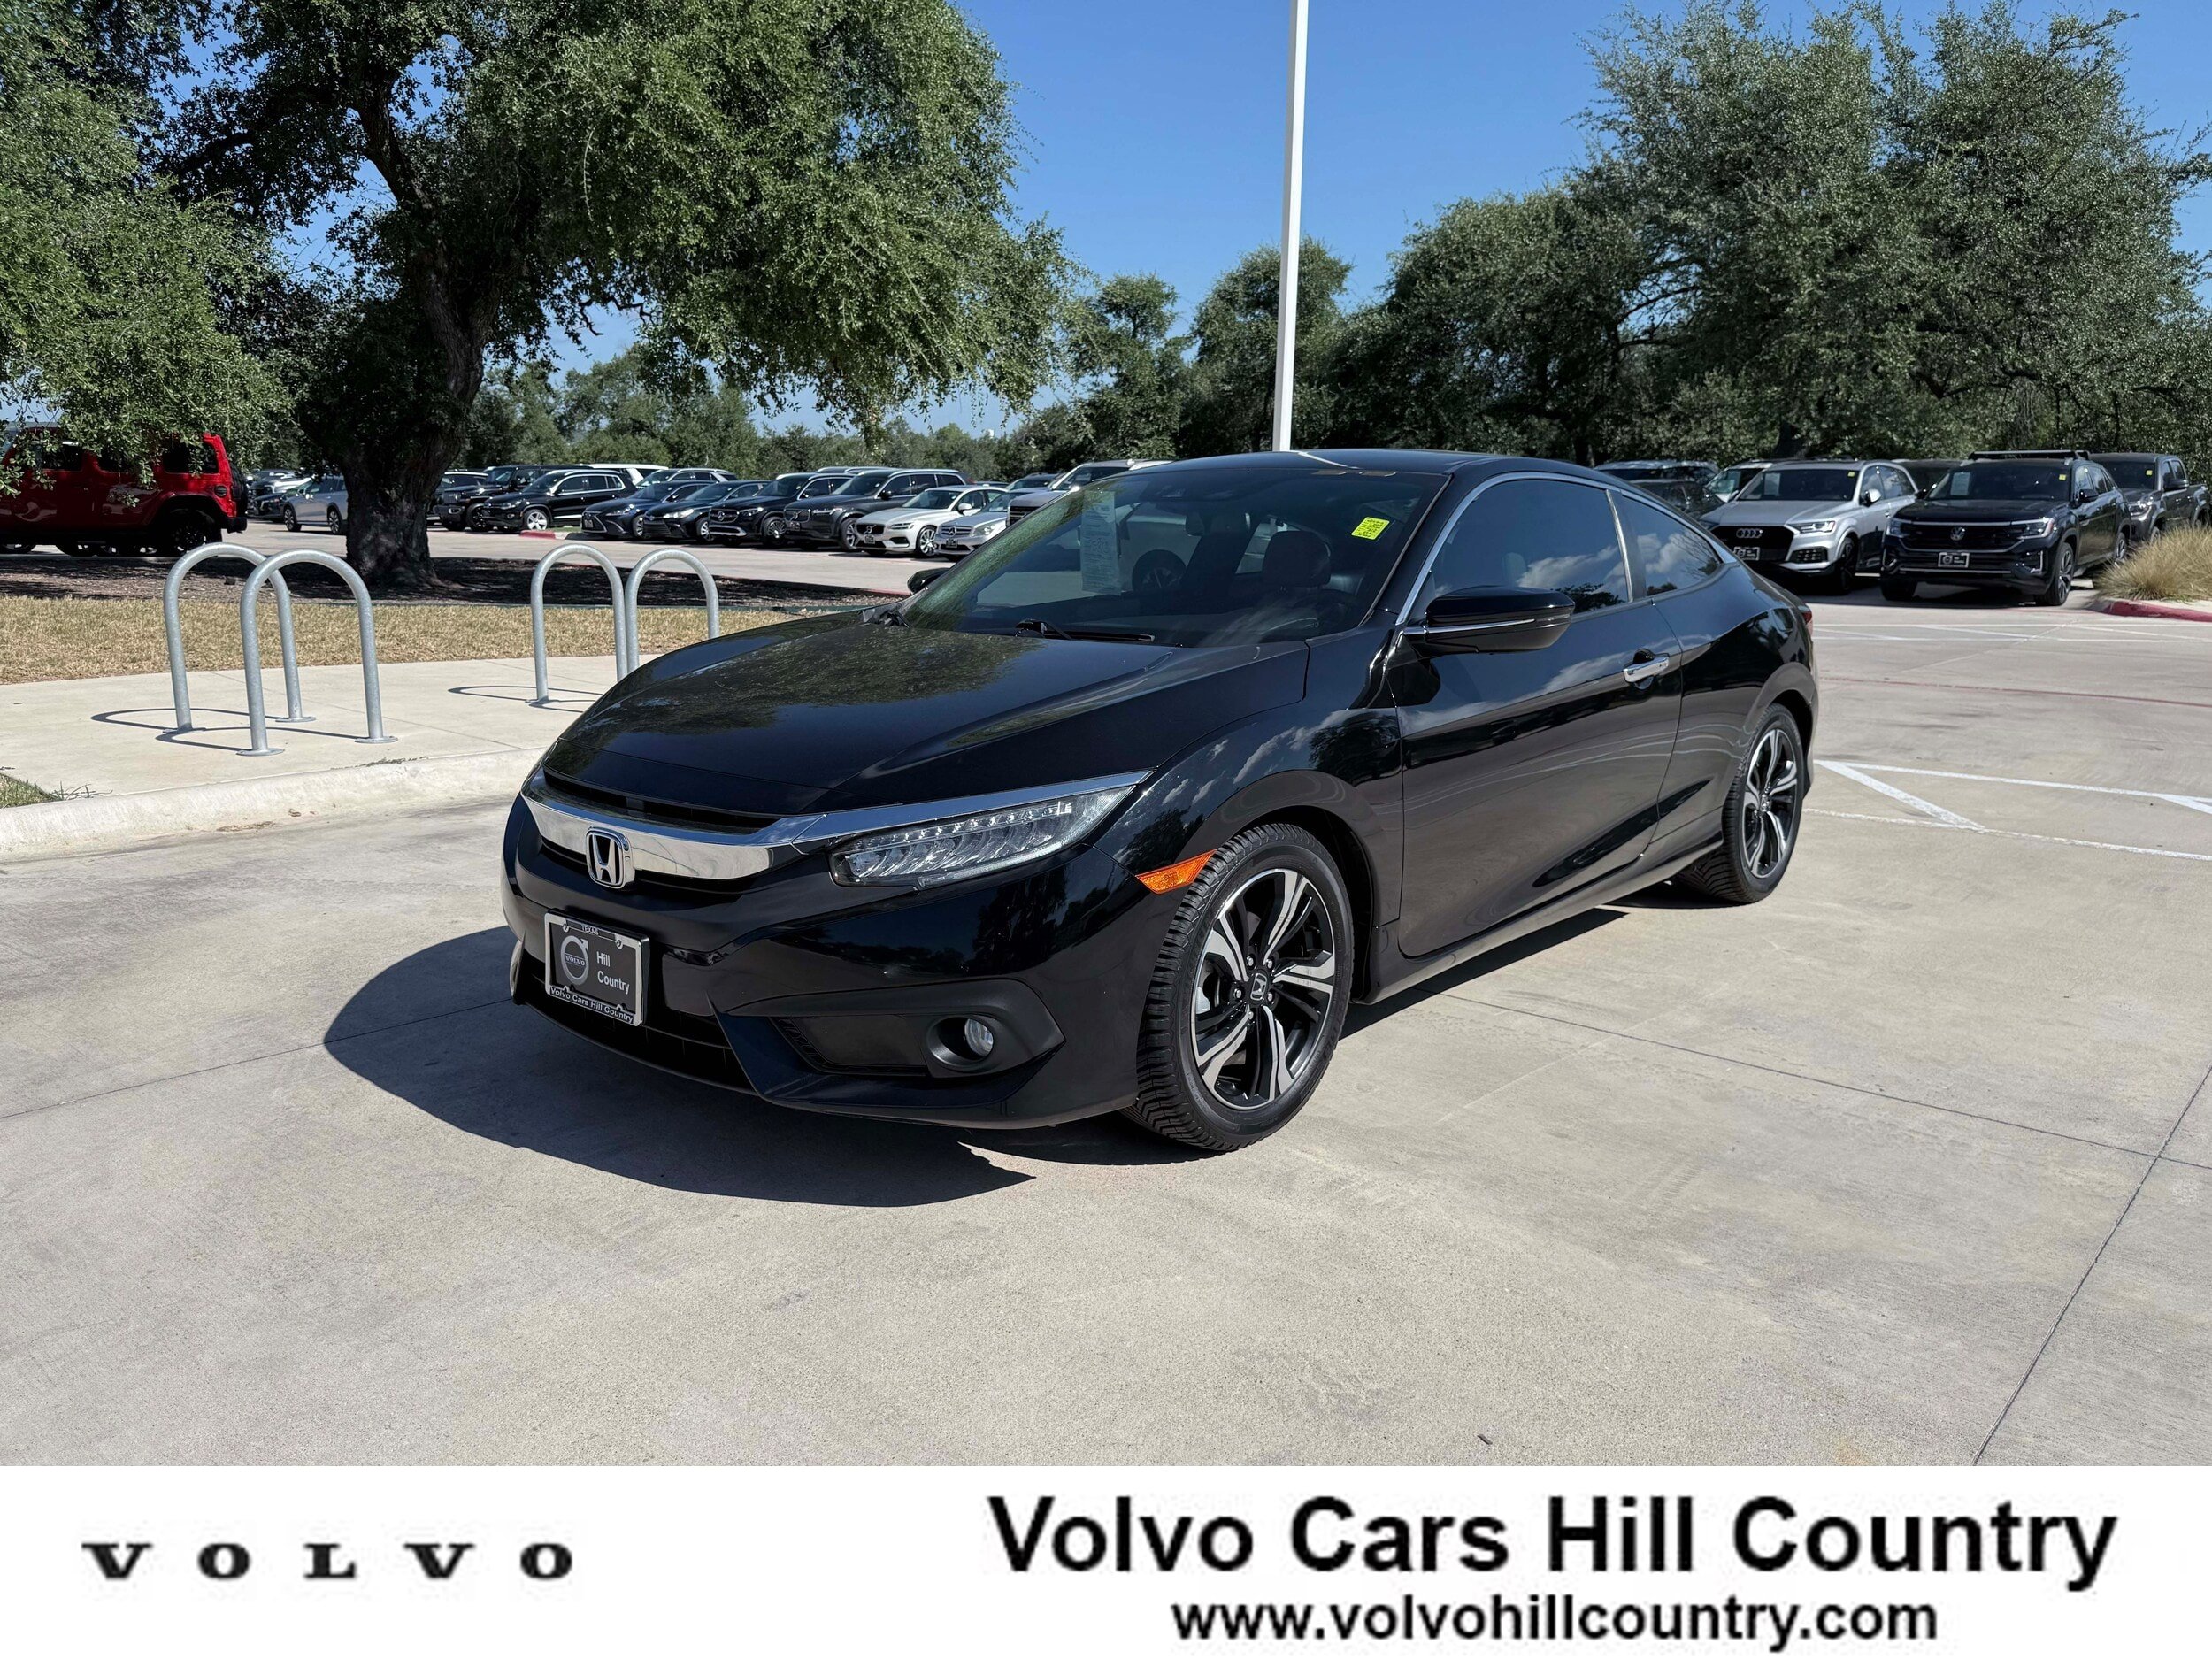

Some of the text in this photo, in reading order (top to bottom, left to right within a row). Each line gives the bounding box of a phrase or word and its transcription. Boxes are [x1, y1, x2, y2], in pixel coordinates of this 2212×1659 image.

[580, 925, 599, 935] TEXAS
[565, 955, 586, 966] VOLVO
[596, 950, 611, 967] Hill
[597, 970, 630, 995] Country
[549, 986, 634, 1024] Volvo Cars Hill Country
